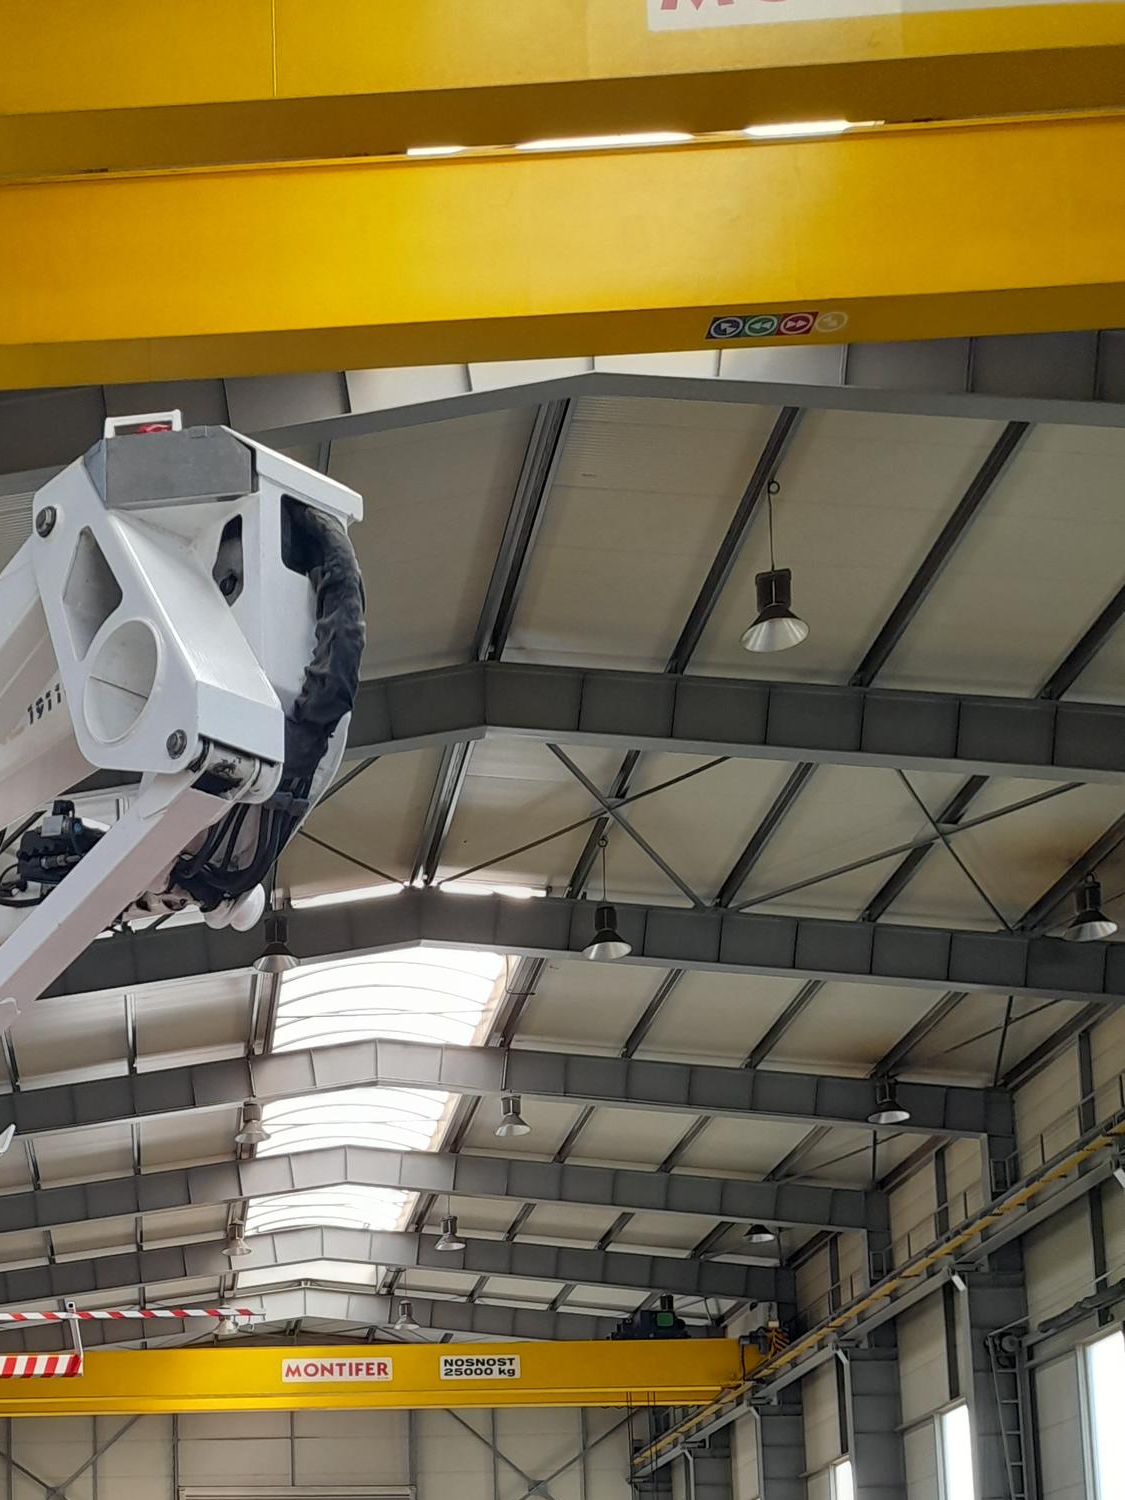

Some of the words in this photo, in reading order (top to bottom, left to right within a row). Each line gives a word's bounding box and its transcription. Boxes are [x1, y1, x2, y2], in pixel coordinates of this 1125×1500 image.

[444, 1358, 515, 1367] NOSNOST
[285, 1362, 389, 1378] MONTIFER
[444, 1367, 493, 1376] 25000
[498, 1367, 515, 1377] kg
